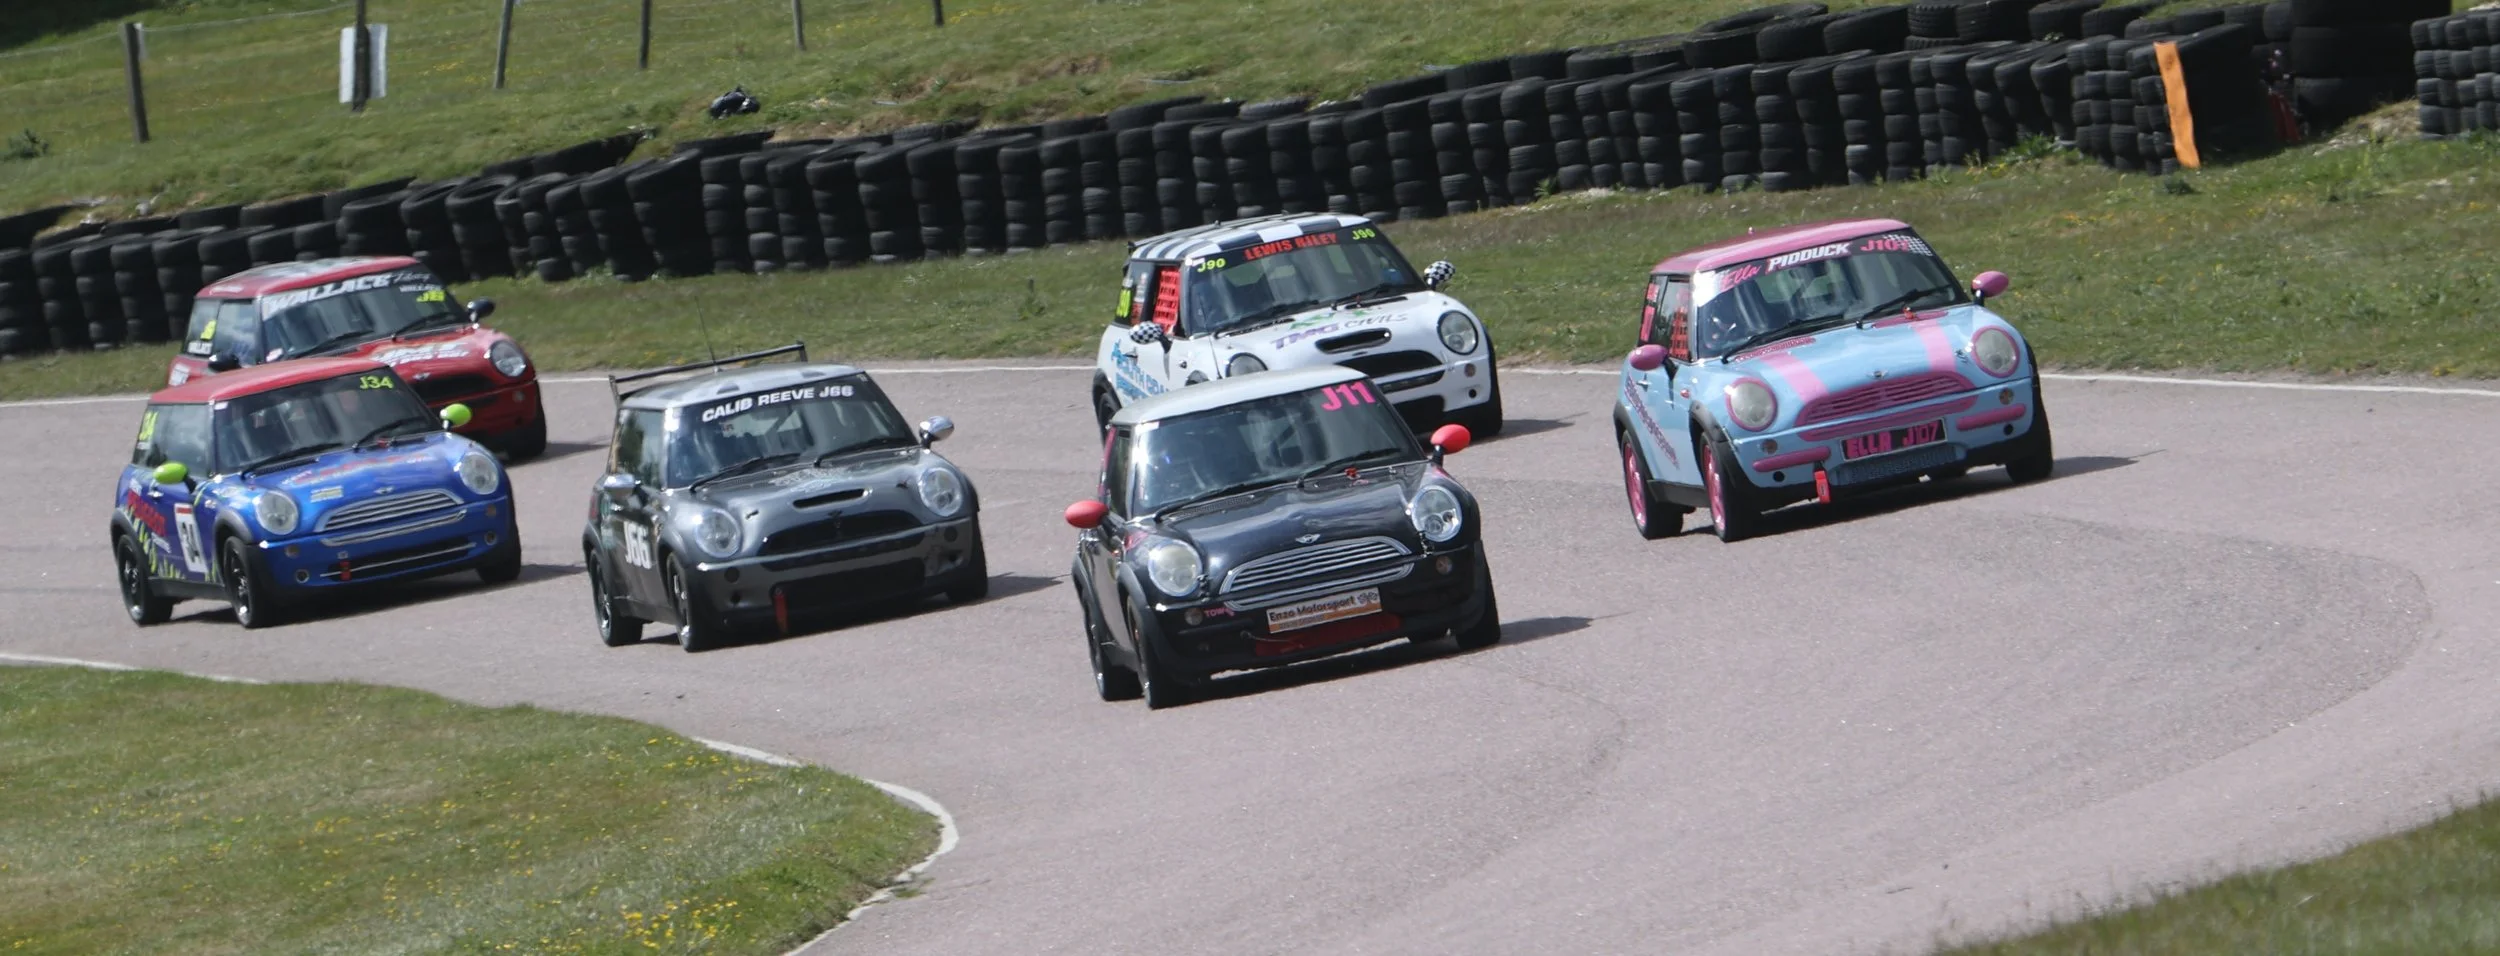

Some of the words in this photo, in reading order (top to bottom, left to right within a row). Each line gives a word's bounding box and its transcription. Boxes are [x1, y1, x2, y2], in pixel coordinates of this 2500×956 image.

[1352, 228, 1376, 240] J90
[1244, 239, 1294, 260] LEWIS
[1197, 258, 1226, 272] J90
[1719, 264, 1762, 292] Ella
[1767, 242, 1851, 273] PIDDUCK
[262, 272, 393, 321] WALLACE
[360, 375, 394, 389] J34
[1321, 380, 1376, 411] J11
[702, 396, 753, 422] CALIB
[758, 386, 814, 407] REEVE
[819, 385, 854, 398] J66
[1846, 431, 1893, 460] ELLA
[623, 520, 653, 570] J66
